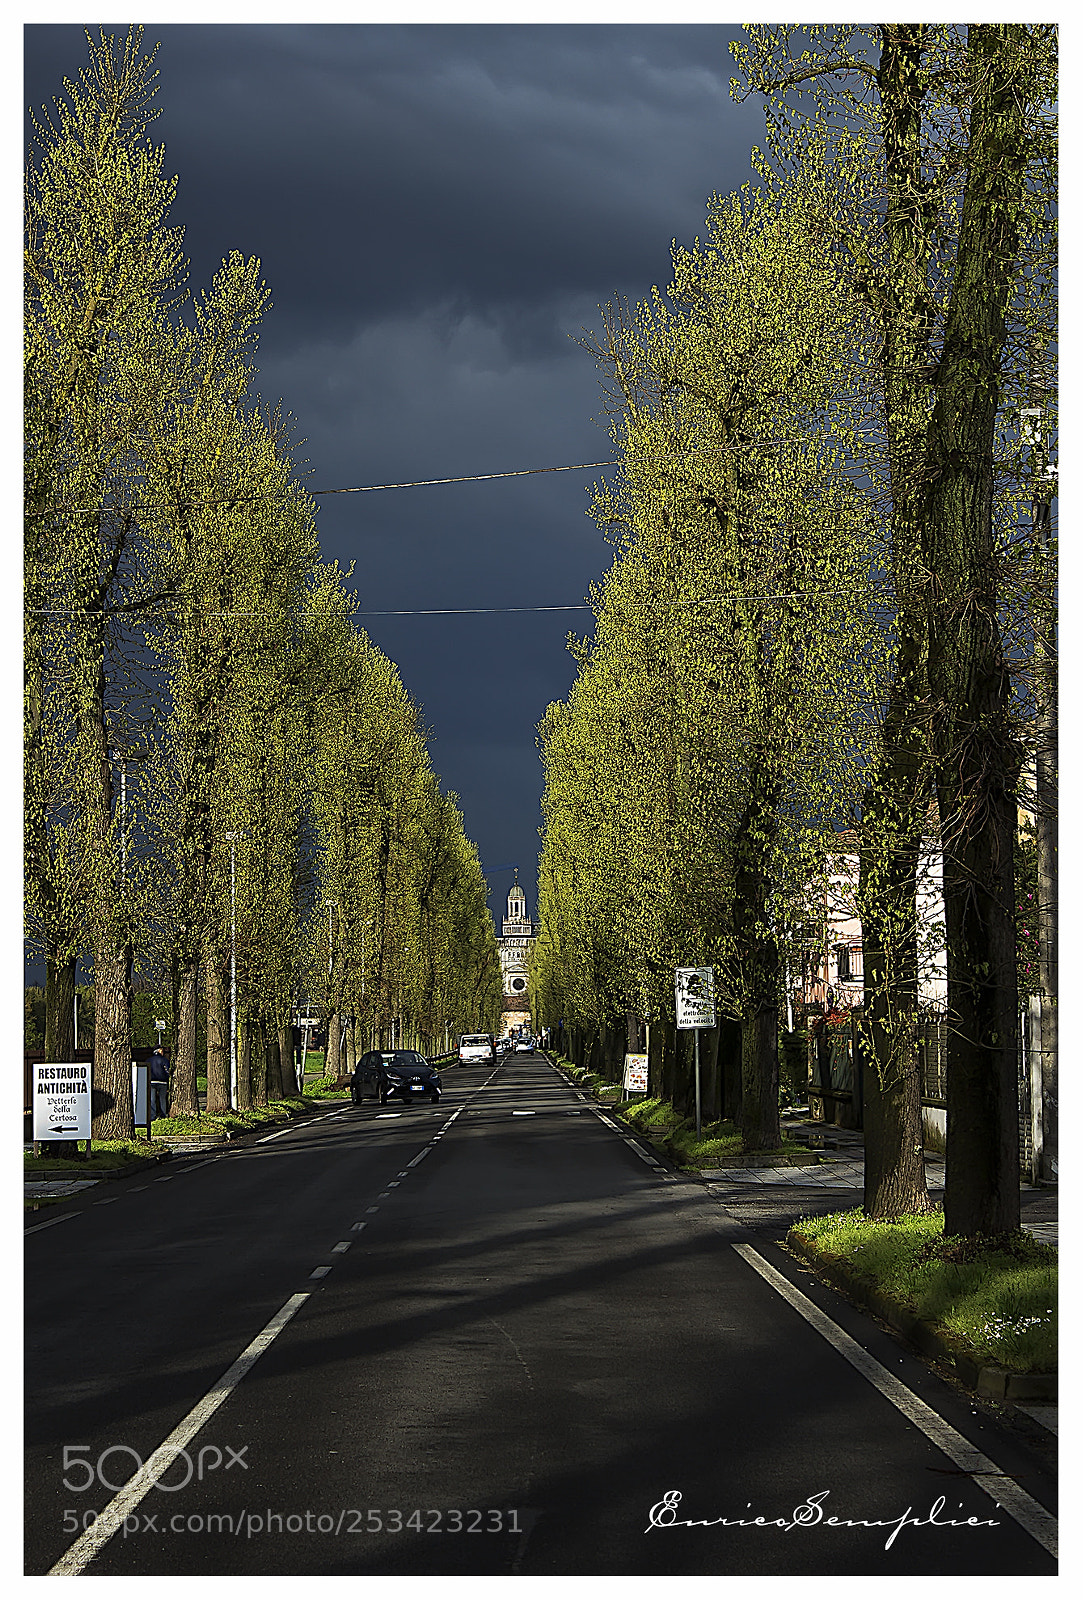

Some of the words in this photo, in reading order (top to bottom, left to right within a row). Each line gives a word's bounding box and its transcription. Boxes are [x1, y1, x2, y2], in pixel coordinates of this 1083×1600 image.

[38, 1067, 87, 1080] RESTAURO
[37, 1080, 88, 1094] ANTICHITÀ
[53, 1105, 71, 1113] della
[49, 1114, 77, 1122] Certosa
